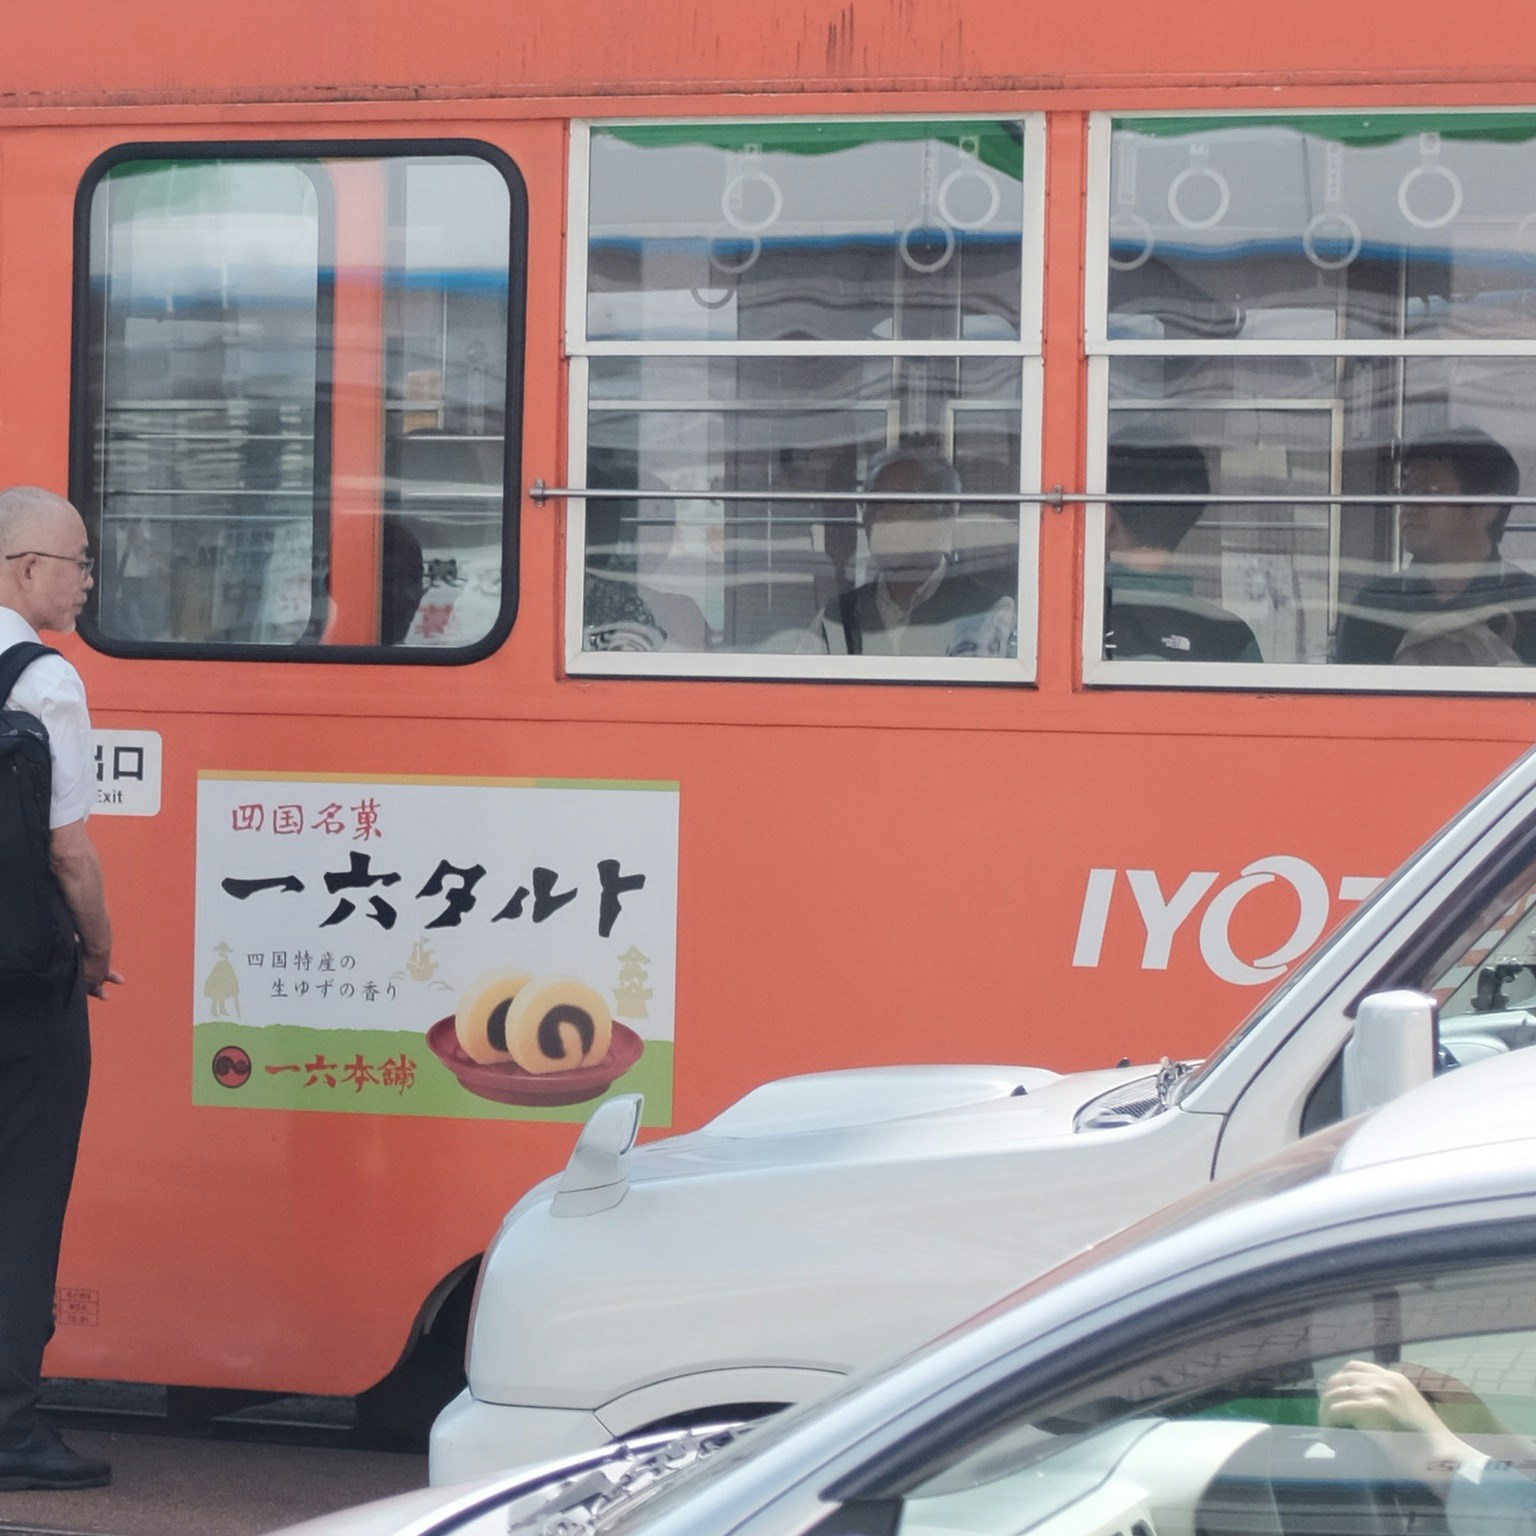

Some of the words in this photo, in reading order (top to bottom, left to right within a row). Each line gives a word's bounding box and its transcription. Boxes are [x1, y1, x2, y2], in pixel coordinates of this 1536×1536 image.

[232, 798, 382, 841] 四国名菓
[221, 850, 646, 938] 一六タルト
[247, 950, 356, 972] 四国特産の
[271, 978, 397, 1002] 生ゆずの香り
[265, 1053, 417, 1095] 一六本舗
